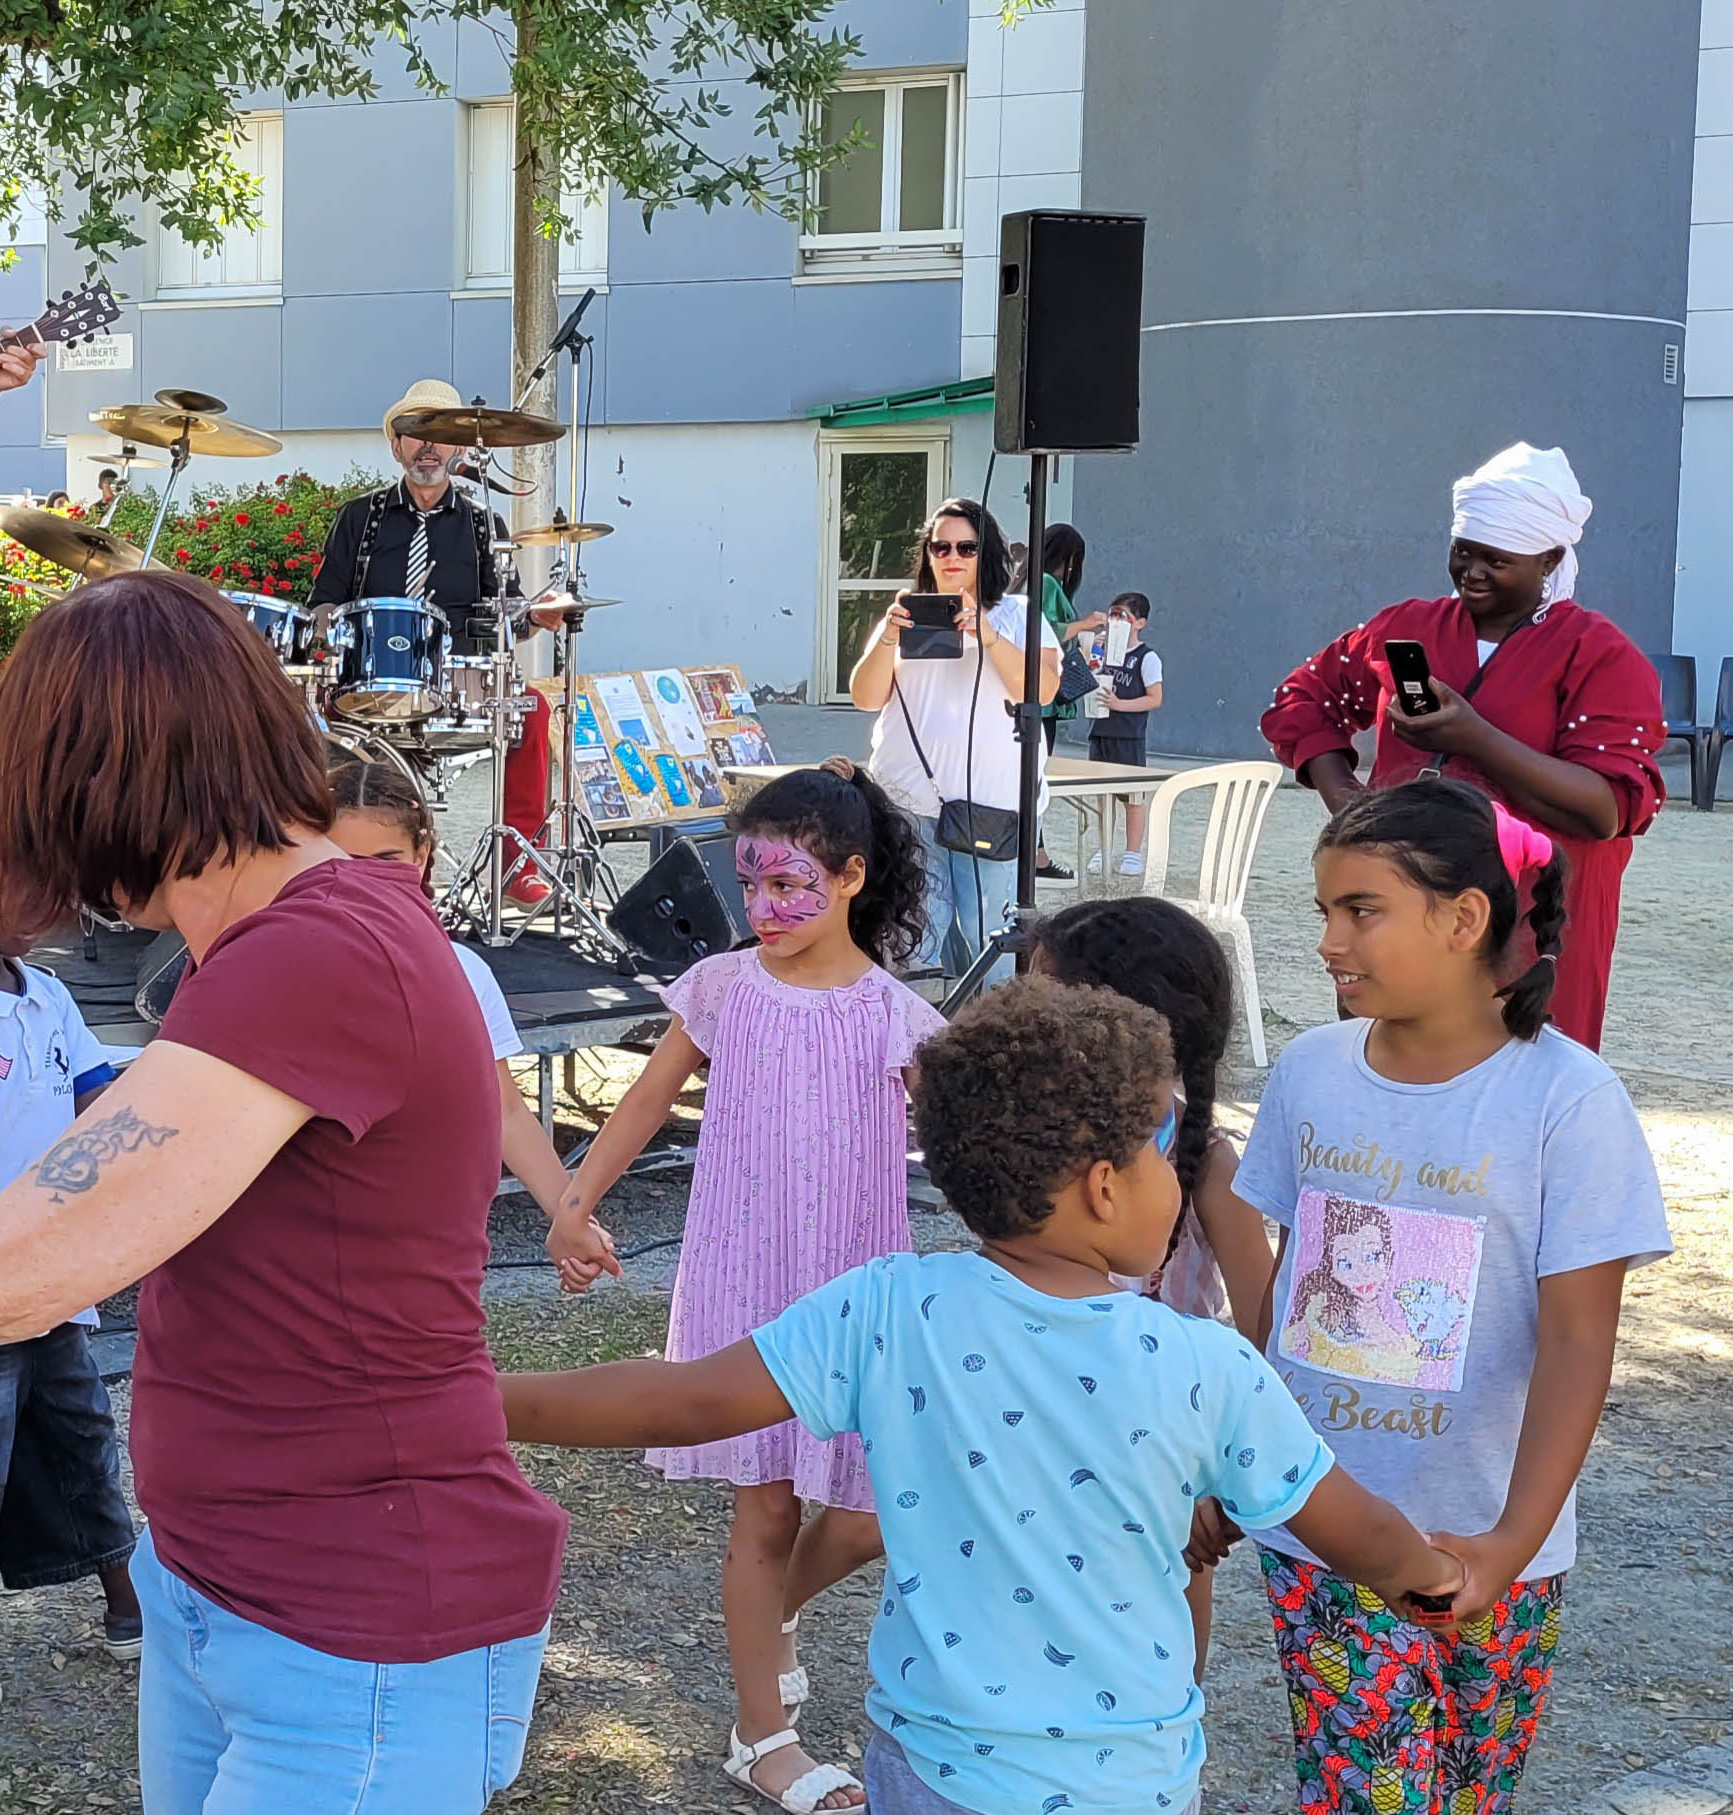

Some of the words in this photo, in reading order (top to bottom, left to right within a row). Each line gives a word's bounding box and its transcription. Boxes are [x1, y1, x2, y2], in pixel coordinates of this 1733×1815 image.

[1299, 1121, 1404, 1201] Beauty
[1417, 1152, 1494, 1197] and
[1320, 1382, 1453, 1440] Beast
